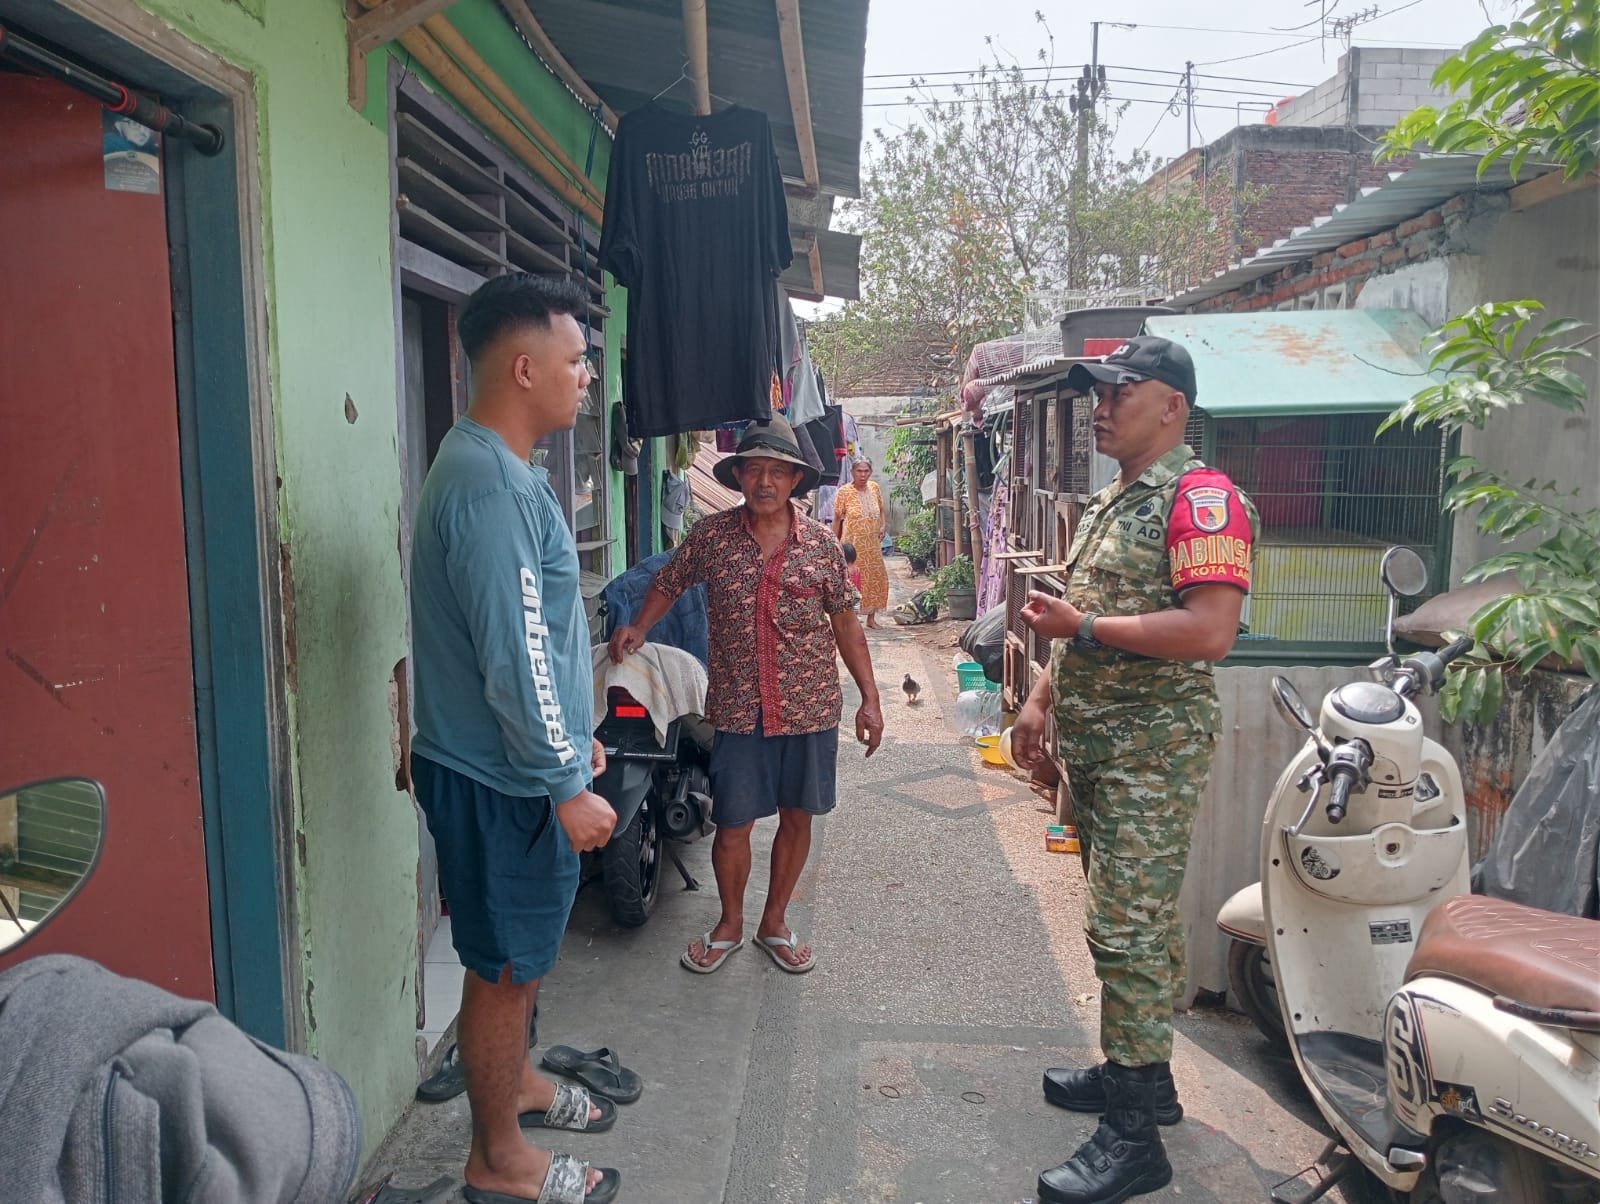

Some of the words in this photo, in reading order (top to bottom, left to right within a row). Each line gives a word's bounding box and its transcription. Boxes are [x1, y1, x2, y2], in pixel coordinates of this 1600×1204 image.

[1137, 525, 1161, 540] AD
[1190, 564, 1227, 578] KOTA
[519, 566, 576, 767] unbeaten
